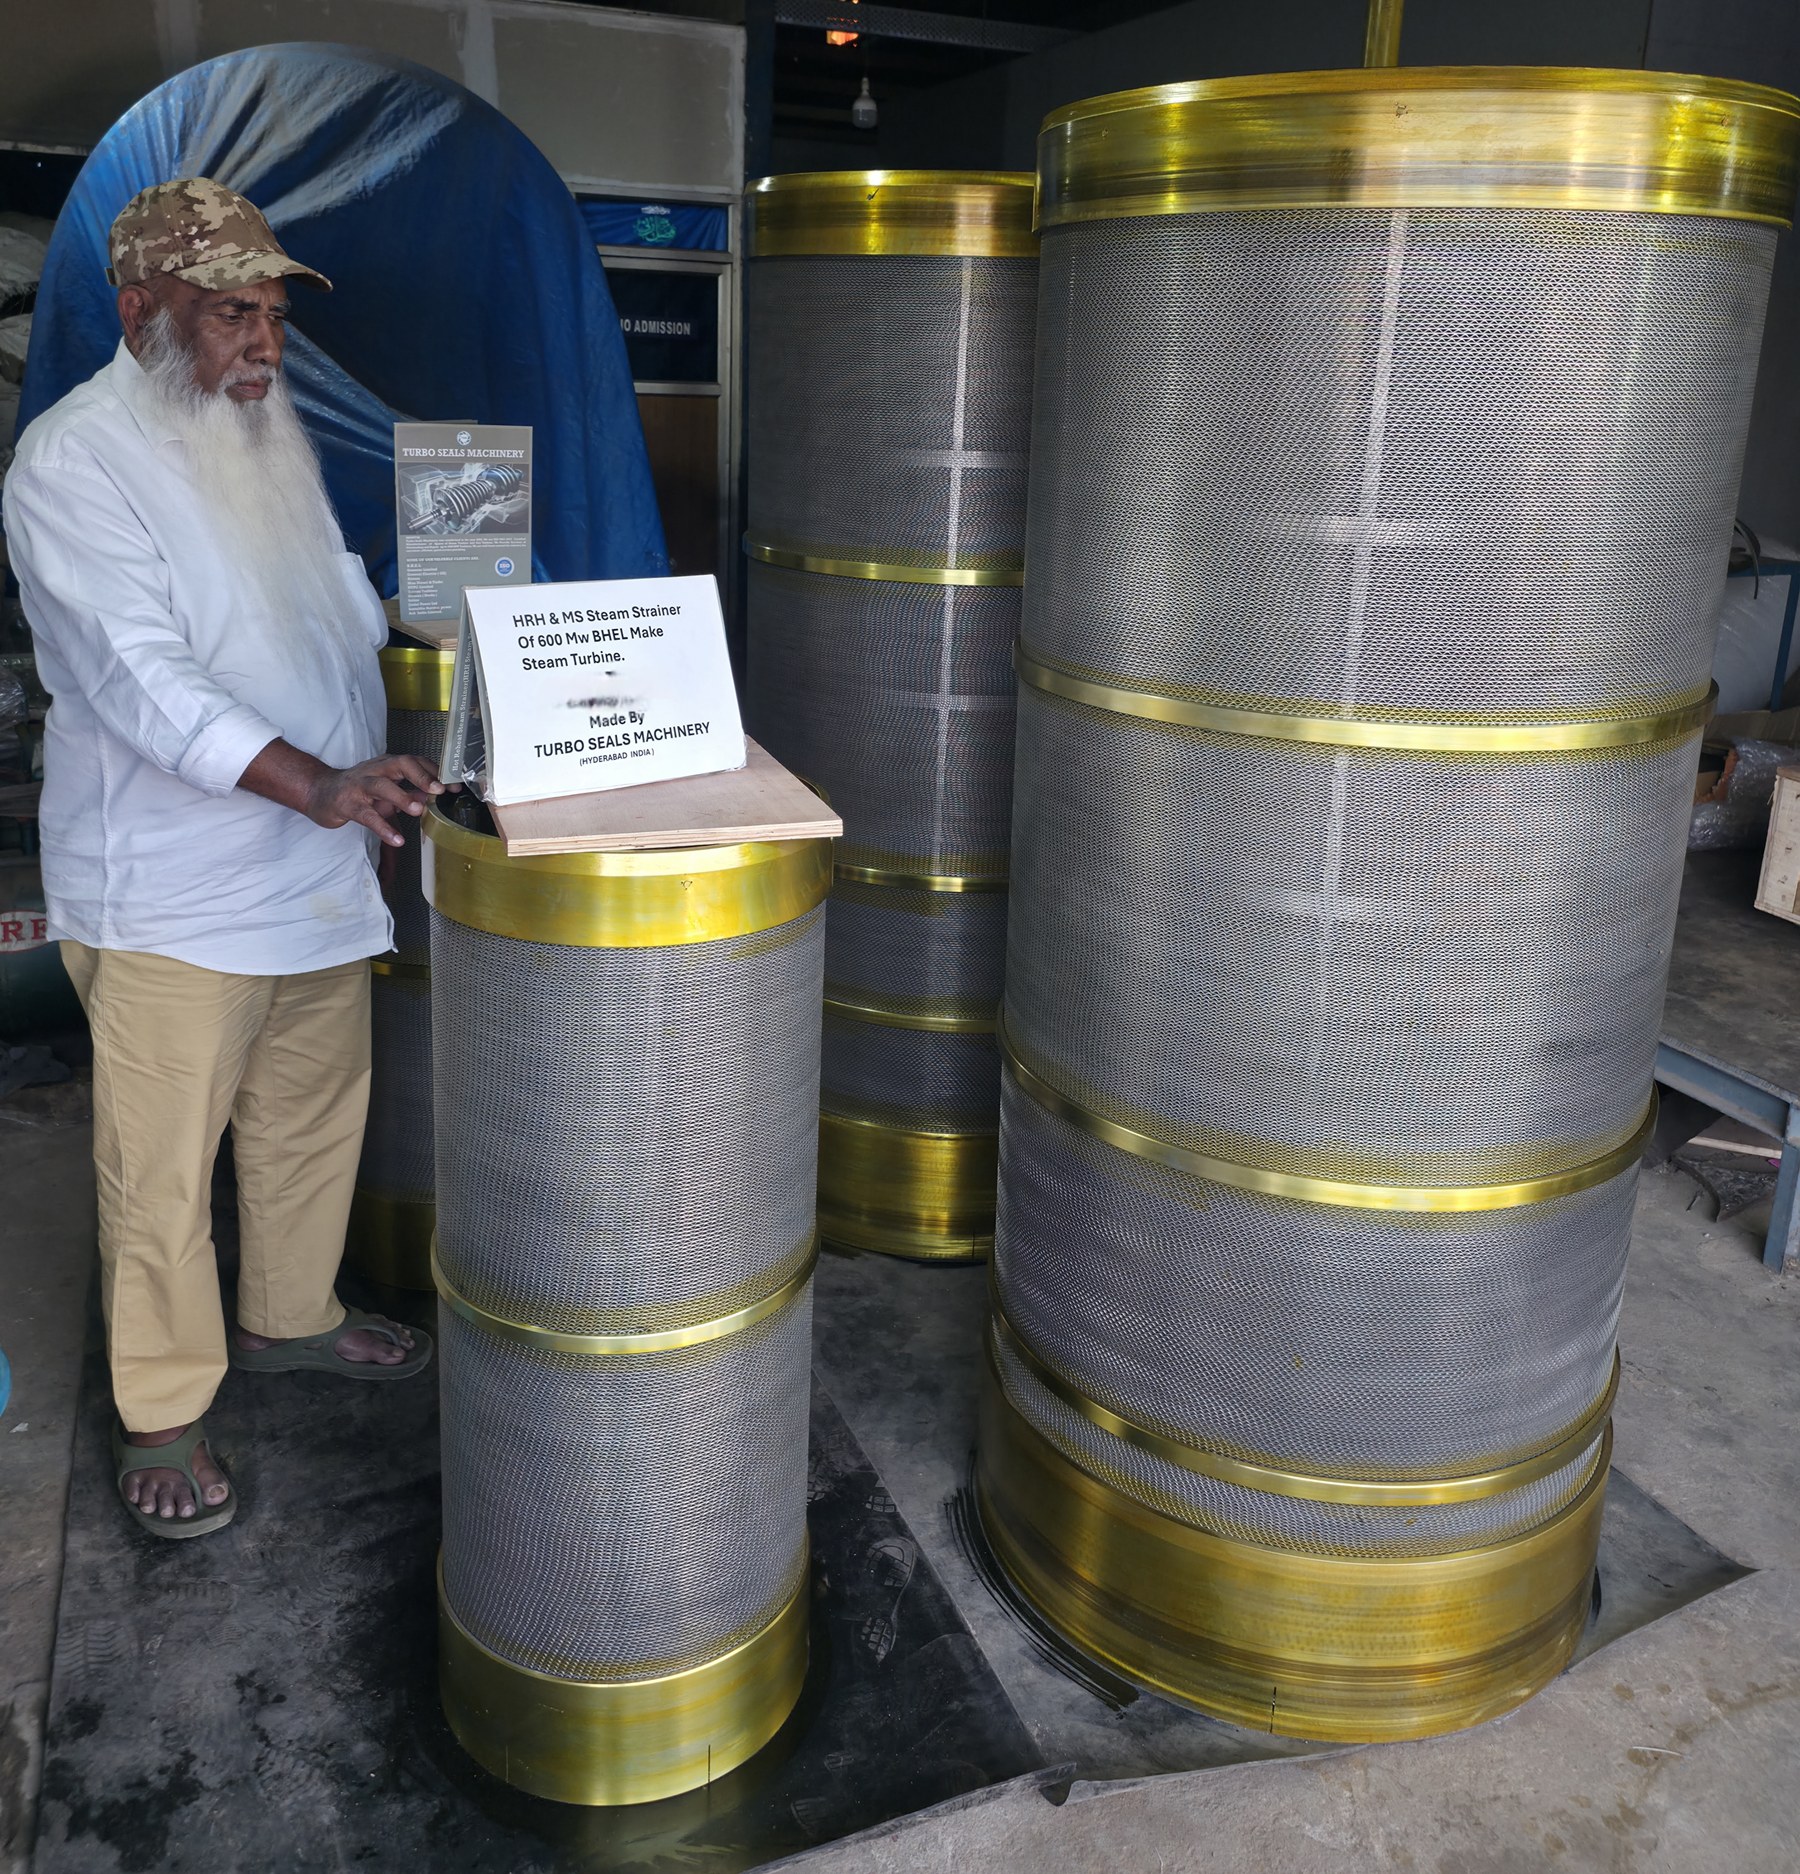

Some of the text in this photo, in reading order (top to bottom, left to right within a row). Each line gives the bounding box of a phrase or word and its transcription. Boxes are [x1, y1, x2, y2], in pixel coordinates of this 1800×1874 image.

[633, 319, 691, 335] ADMISSION
[402, 448, 525, 458] TURBO SEALS MACHINERY
[512, 604, 681, 627] HRH & MS Steam Strainer
[518, 625, 664, 649] Of 600 Mw BHEL Make
[522, 650, 625, 671] Steam Turbine.
[457, 711, 466, 734] Steam
[589, 710, 645, 728] Made By
[453, 734, 463, 758] Reheat
[534, 721, 710, 758] TURBO SEALS MACHINERY
[579, 752, 628, 766] (HYDERABAD
